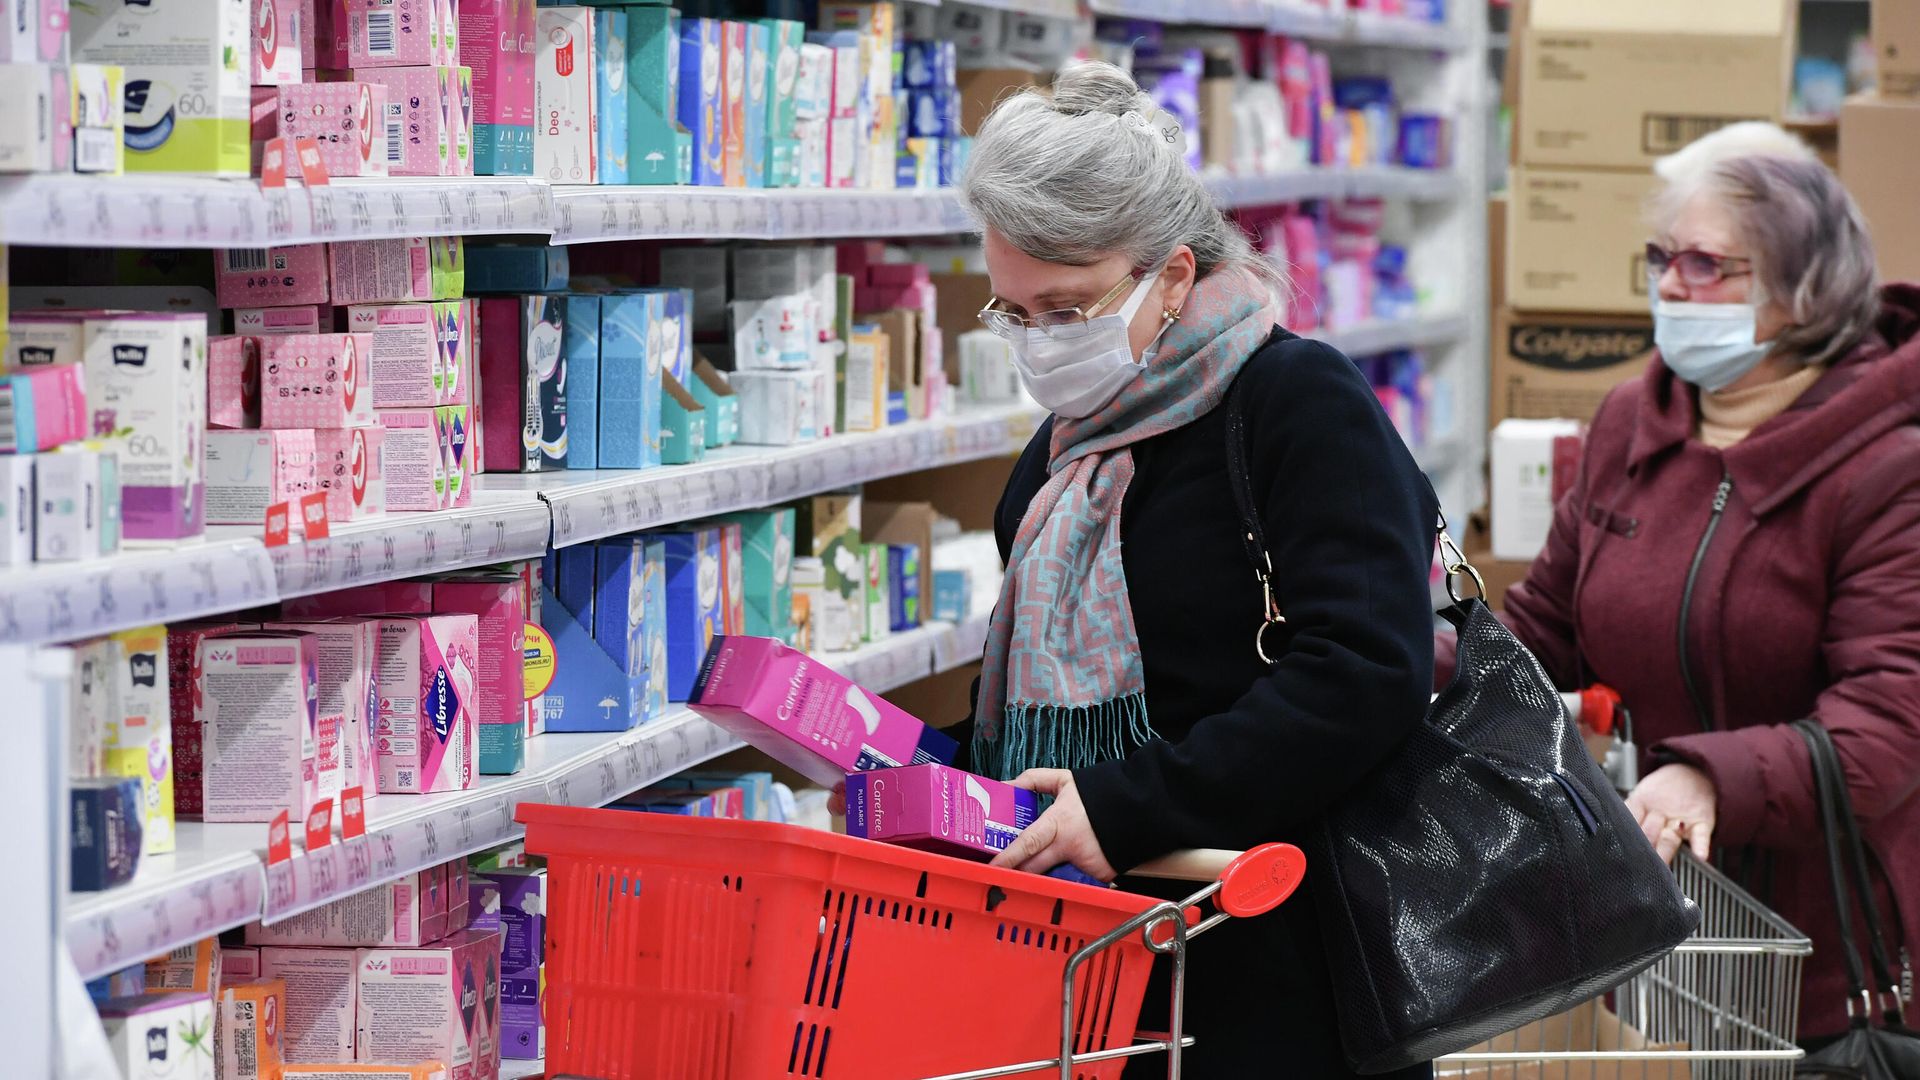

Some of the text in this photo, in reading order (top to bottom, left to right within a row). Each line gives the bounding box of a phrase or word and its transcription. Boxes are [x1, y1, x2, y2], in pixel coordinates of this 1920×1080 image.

[549, 111, 559, 136] Deo
[1515, 327, 1645, 362] Colgate
[435, 670, 447, 736] Libresse
[777, 661, 808, 721] Carefree
[873, 779, 885, 832] Carefree
[940, 770, 949, 836] Carefree
